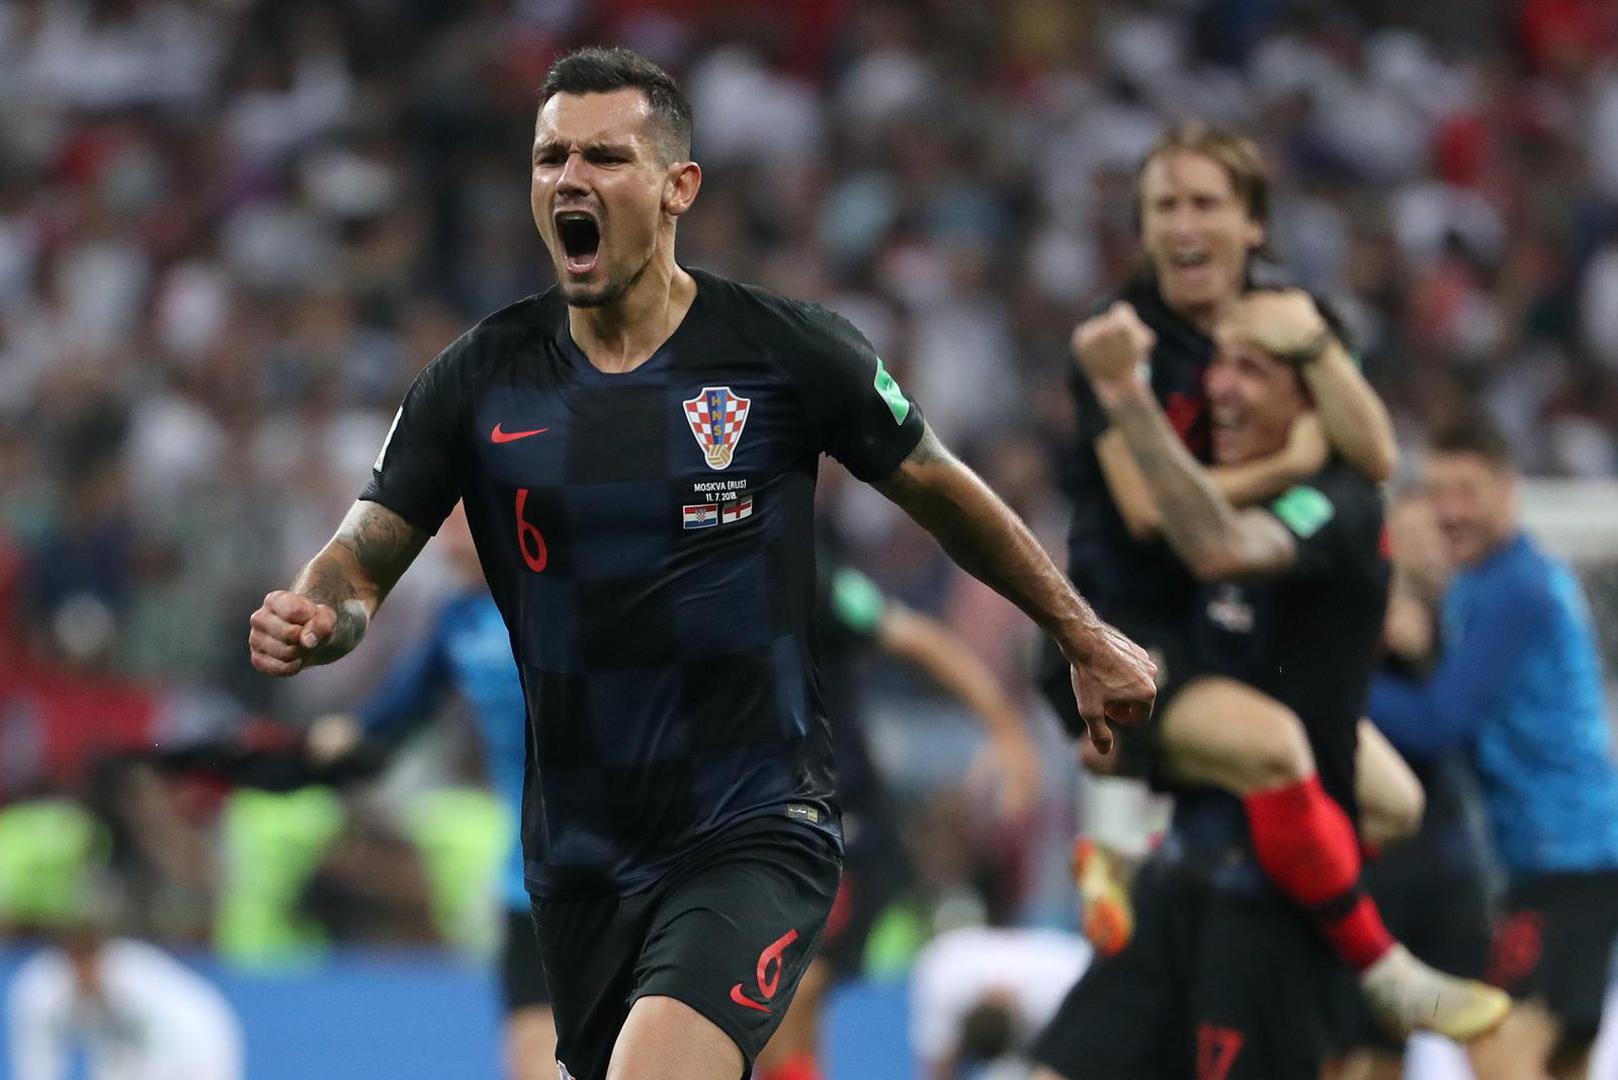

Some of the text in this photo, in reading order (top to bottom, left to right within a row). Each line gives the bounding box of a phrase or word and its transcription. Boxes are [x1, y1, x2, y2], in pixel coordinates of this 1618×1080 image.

[694, 482, 727, 492] MOSKVA
[515, 488, 548, 573] 6
[756, 928, 799, 999] 6
